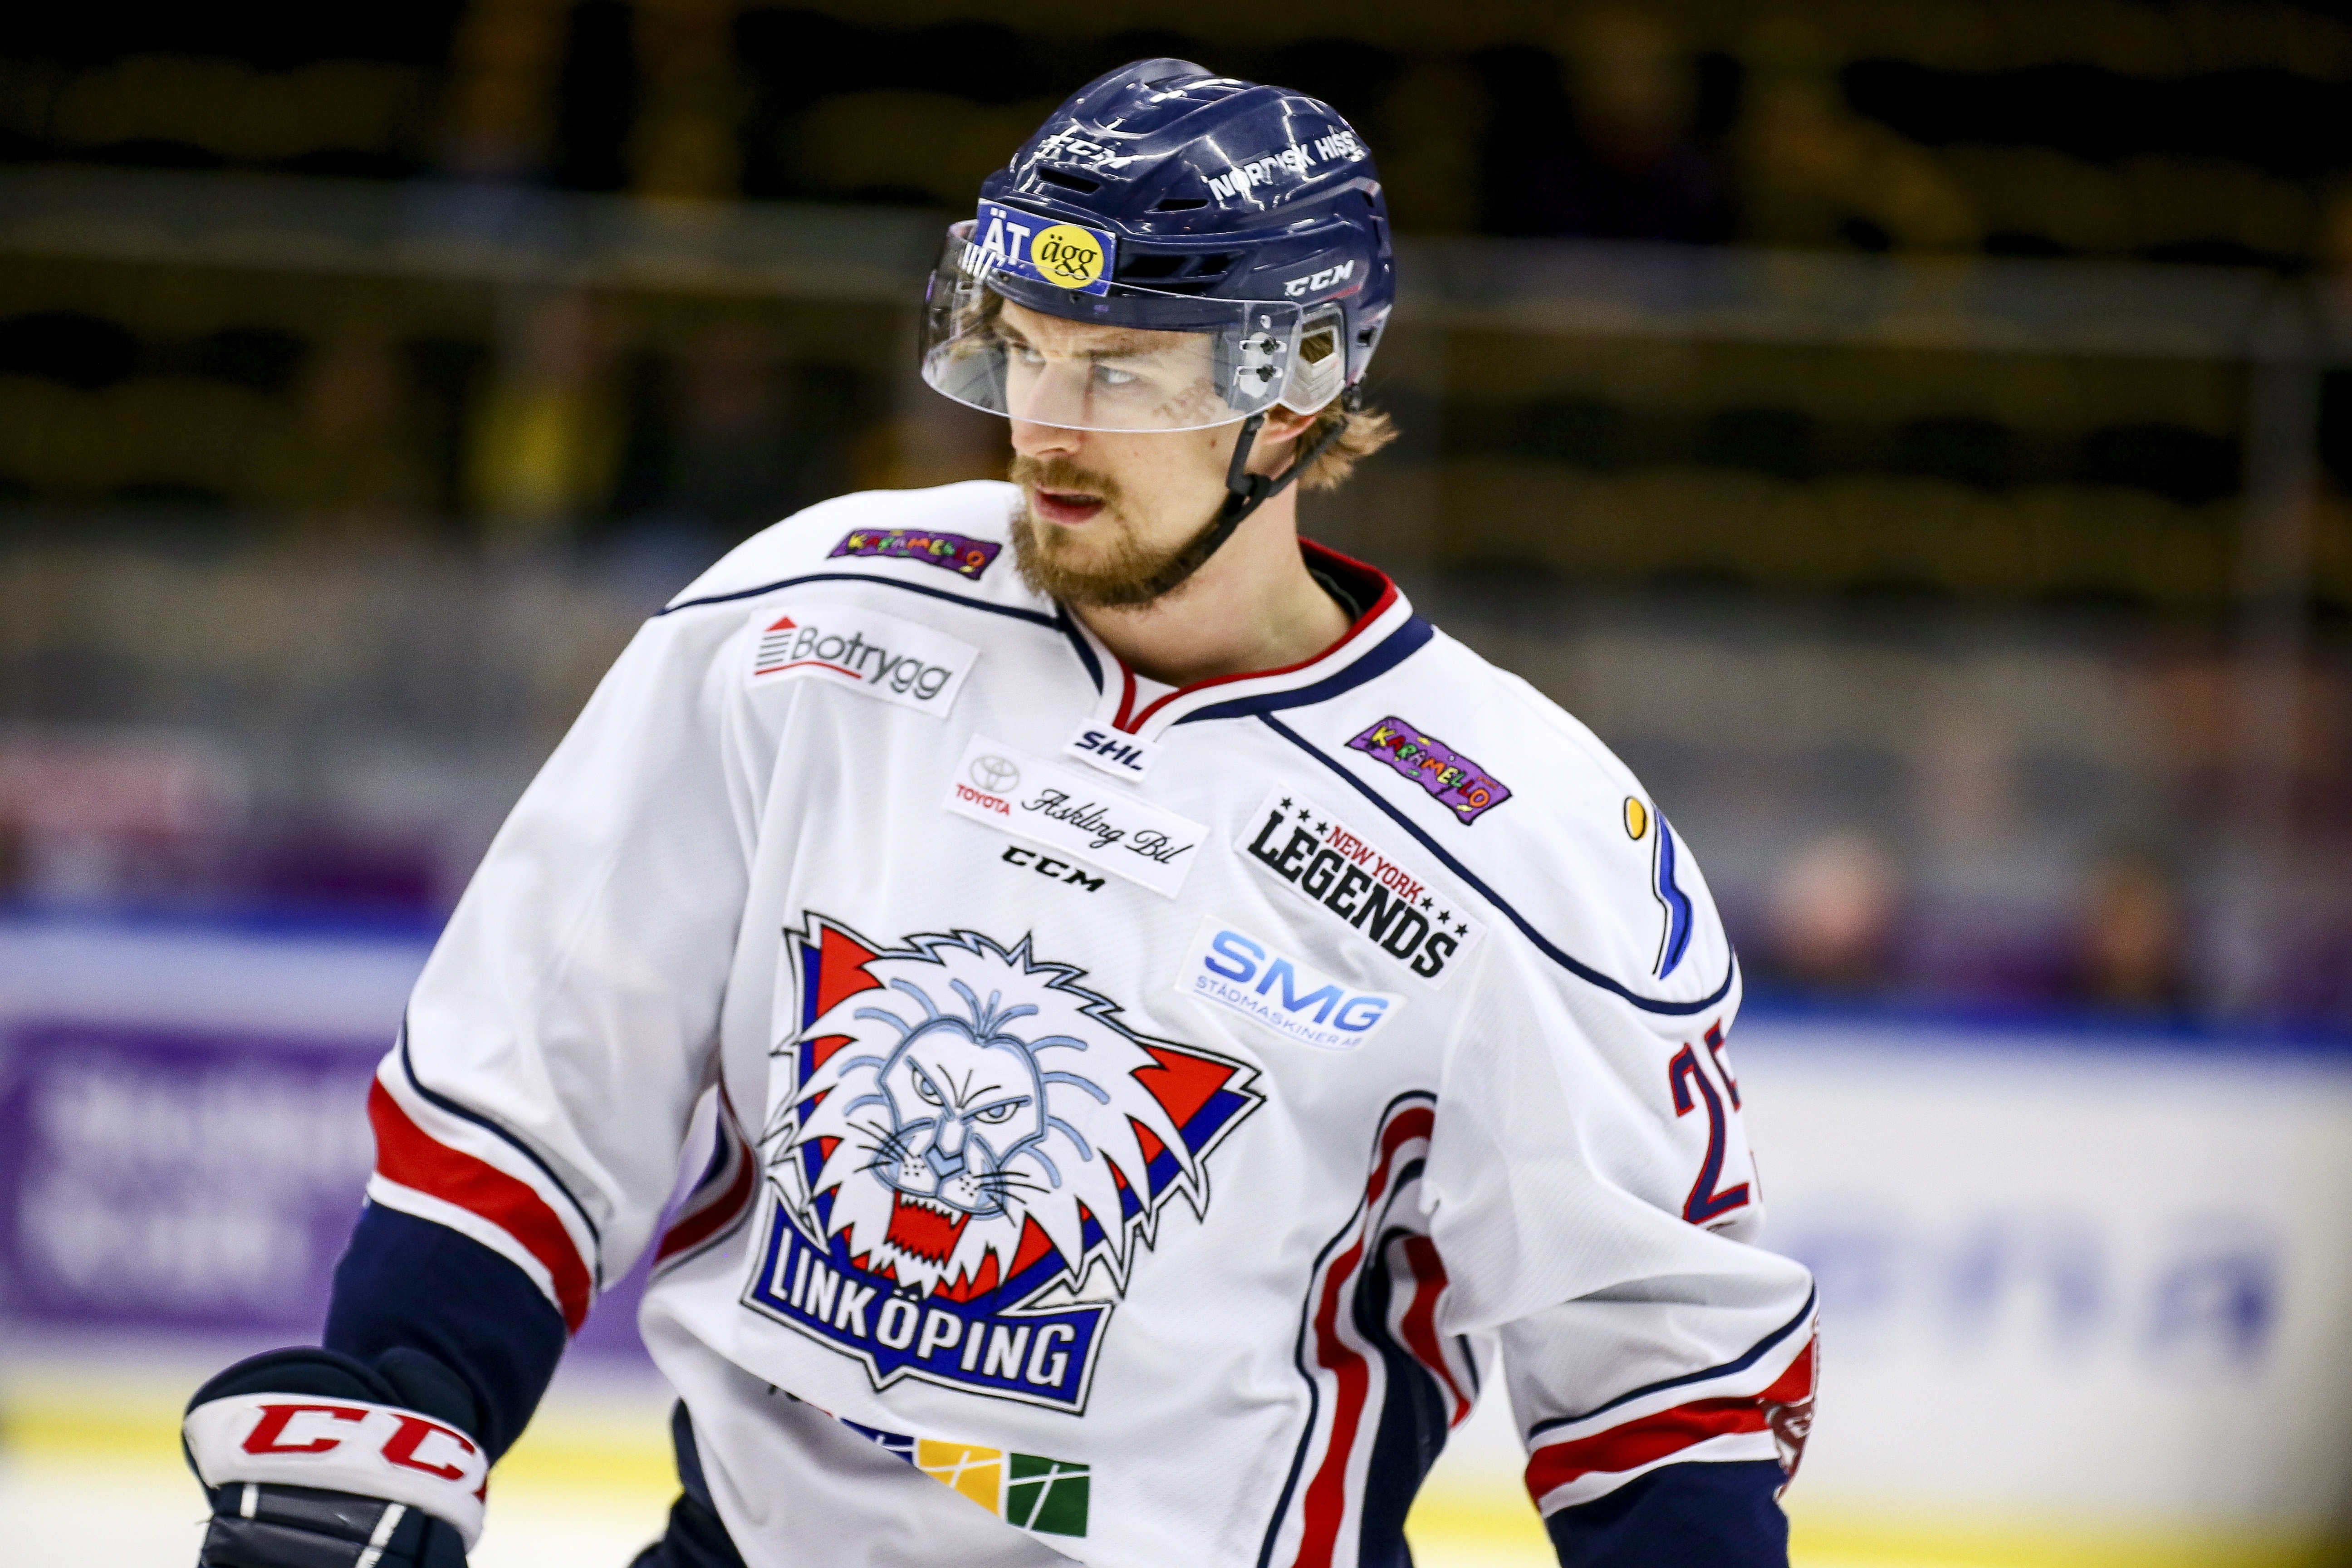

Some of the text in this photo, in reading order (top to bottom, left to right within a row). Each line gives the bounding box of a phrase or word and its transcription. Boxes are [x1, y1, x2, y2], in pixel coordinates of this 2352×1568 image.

[1314, 130, 1357, 162] HISS
[982, 207, 1097, 281] ÄT ägg
[1284, 260, 1355, 297] CCM
[790, 625, 952, 700] Botrygg
[1074, 731, 1143, 770] SHL
[1372, 725, 1490, 808] KARAMELLO
[956, 783, 1011, 816] TOYOTA
[1001, 844, 1106, 892] CCM
[1124, 829, 1195, 864] Bil
[1325, 825, 1426, 904] NEW YORK
[1247, 809, 1459, 978] LEGENDS
[1204, 930, 1389, 1032] SMG
[769, 1227, 1077, 1388] LINKÖPING
[241, 1404, 487, 1503] CC
